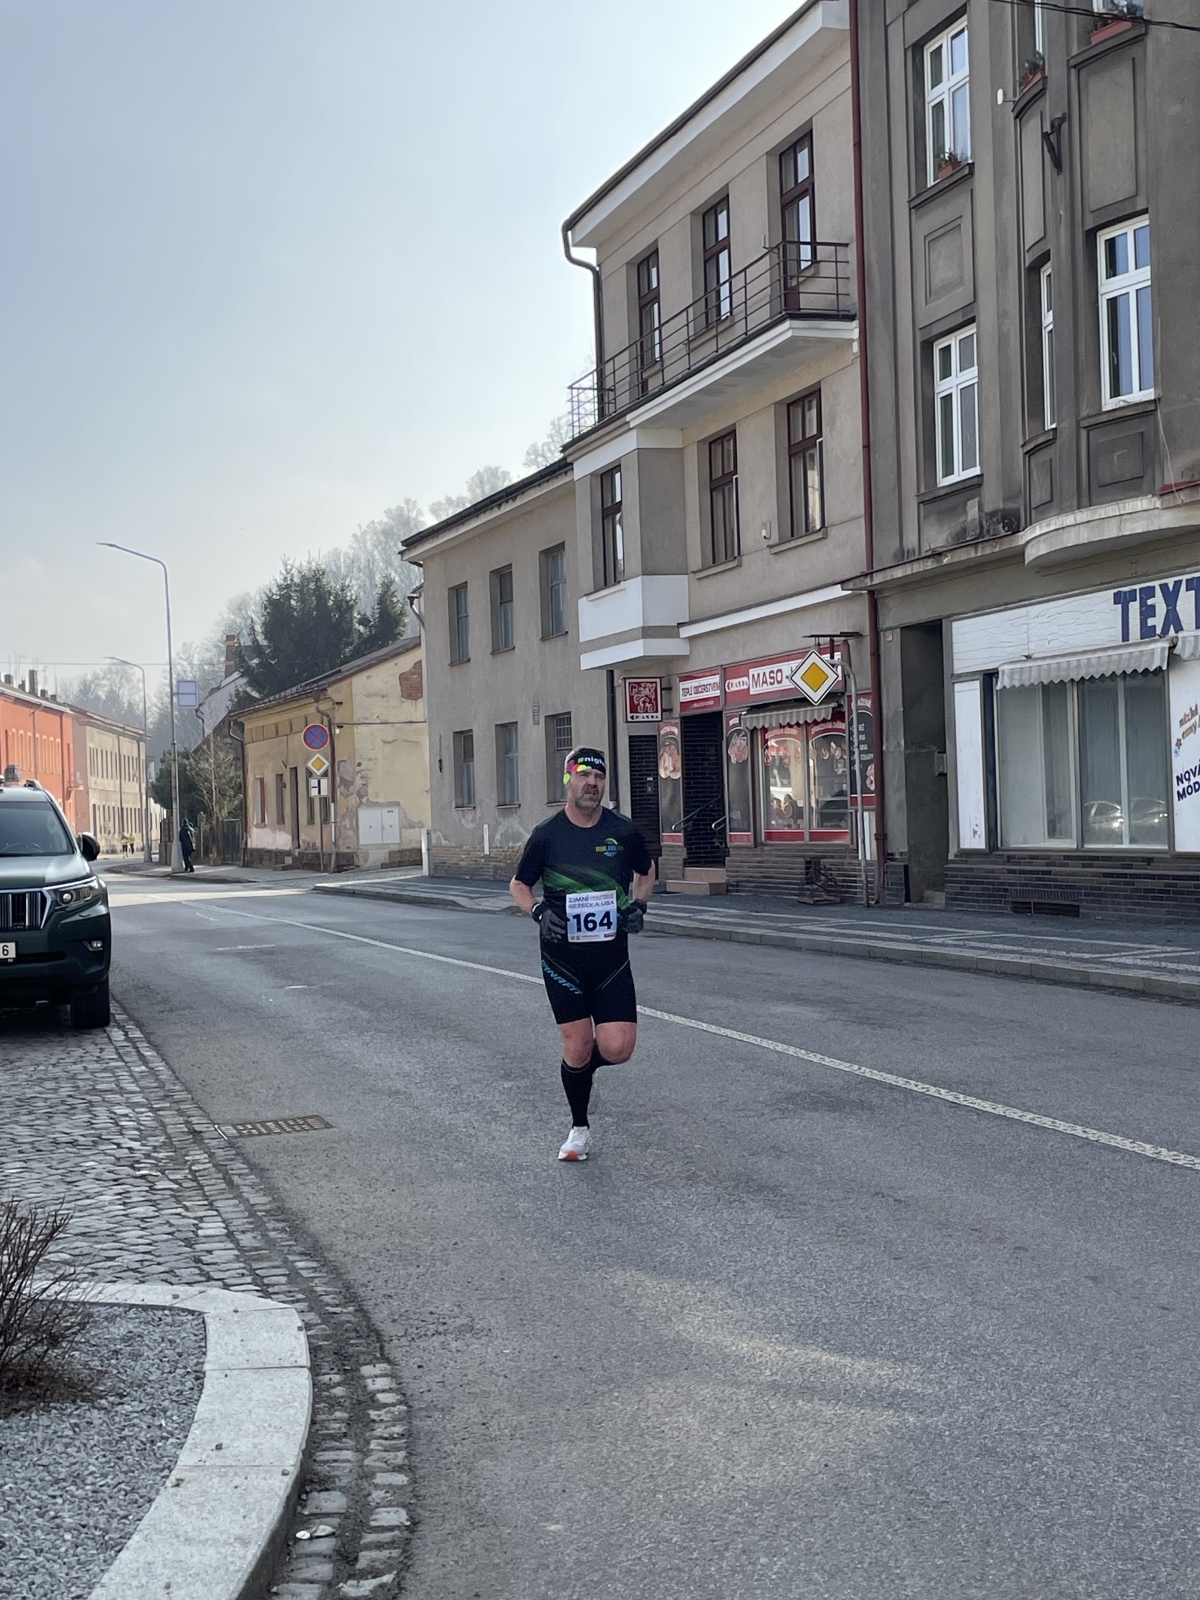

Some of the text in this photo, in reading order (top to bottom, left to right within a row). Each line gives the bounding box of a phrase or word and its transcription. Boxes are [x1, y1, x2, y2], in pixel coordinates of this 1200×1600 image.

[751, 668, 783, 689] MASO
[572, 910, 613, 933] 164
[2, 944, 9, 957] 6
